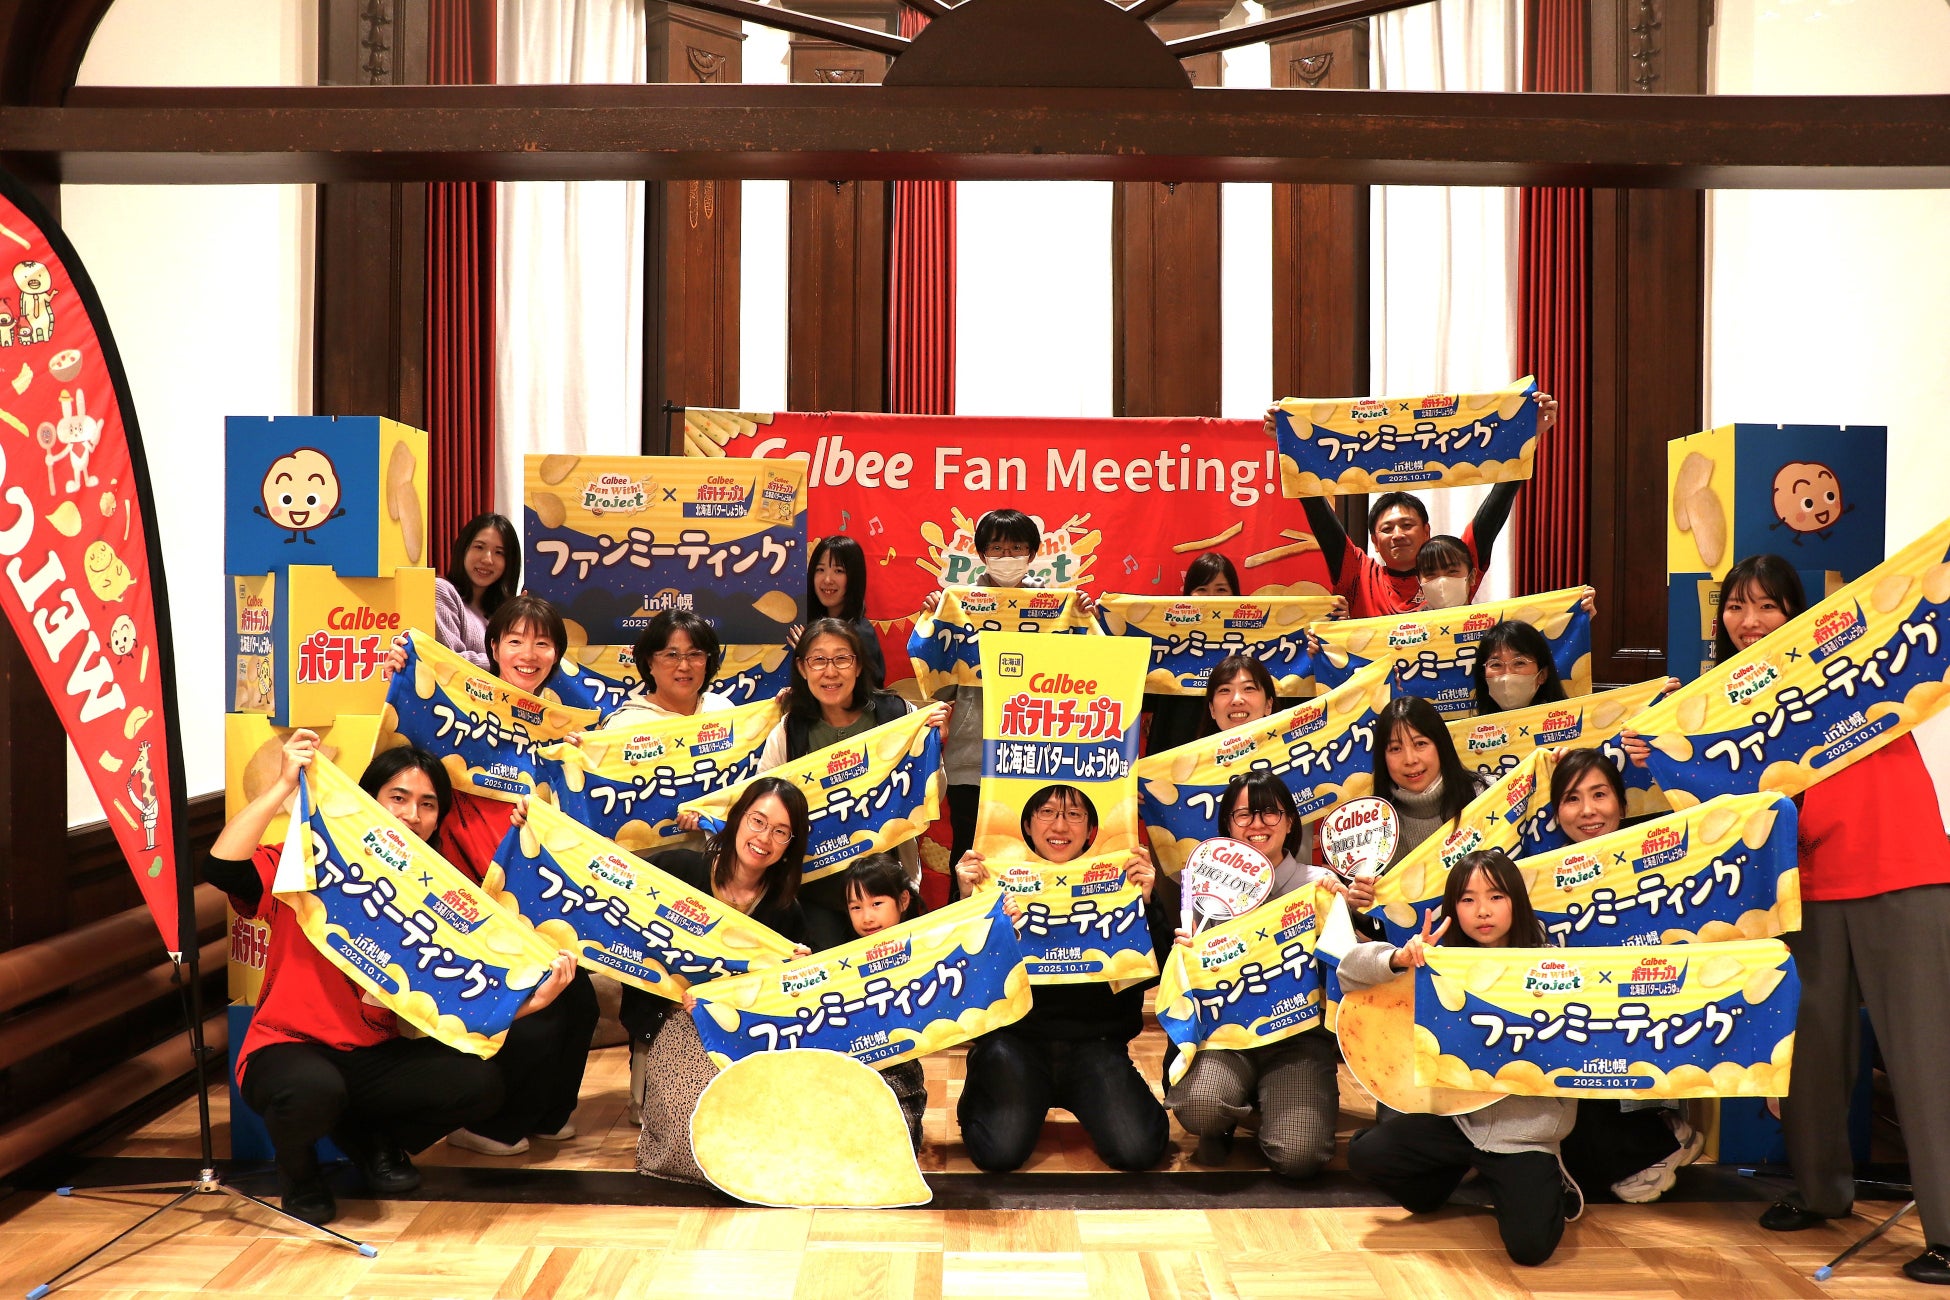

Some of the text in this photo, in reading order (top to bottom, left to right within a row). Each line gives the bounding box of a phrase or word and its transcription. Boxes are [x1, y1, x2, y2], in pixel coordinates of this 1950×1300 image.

[1352, 408, 1388, 418] Project
[1318, 421, 1498, 462] ファンミーティング
[707, 476, 734, 485] Calbee
[751, 435, 1275, 508] lbee Fan Meeting!
[1389, 474, 1431, 482] 2025.10.17
[588, 484, 641, 496] Fan With!
[601, 476, 628, 486] Calbee
[584, 492, 644, 508] Project
[697, 485, 746, 502] ポテトチップス
[536, 528, 796, 580] ファンミーティング
[644, 593, 694, 612] in札幌
[961, 601, 996, 612] Project
[328, 606, 400, 630] Calbee
[1165, 612, 1200, 622] Project
[1815, 610, 1839, 627] Calbee
[1813, 612, 1857, 645] ポテトチップス
[1151, 632, 1302, 663] ァンミーティング
[1389, 632, 1428, 646] Project
[1002, 658, 1021, 666] 北海道
[1733, 664, 1754, 680] Calbee
[466, 682, 493, 701] Project
[1029, 673, 1098, 694] Calbee
[1705, 612, 1938, 771] ファンミーティング
[1727, 667, 1778, 704] Project
[1438, 688, 1470, 700] in札幌
[1001, 694, 1123, 740] ポテトチップス
[1548, 710, 1567, 718] Calbee
[1822, 711, 1867, 743] in札幌
[1468, 734, 1507, 750] Project
[1826, 721, 1884, 760] 2025.10.17
[624, 745, 664, 760] Project
[831, 749, 850, 760] Calbee
[996, 742, 1129, 778] 北海道バターしょうゆ味
[1216, 742, 1256, 764] Project
[484, 778, 524, 792] 2025.10.17
[1335, 807, 1378, 832] Calbee
[386, 830, 405, 848] Calbee
[1445, 830, 1462, 846] Calbee
[1647, 827, 1670, 838] Calbee
[363, 832, 407, 872] Project
[814, 834, 850, 855] in札幌
[1332, 836, 1354, 853] BIG
[1642, 831, 1681, 856] ポテトチップス
[608, 855, 628, 869] Calbee
[814, 846, 861, 868] 2025.10.17
[1212, 847, 1261, 877] Calbee
[1564, 855, 1585, 866] Calbee
[1573, 857, 1596, 872] With!
[588, 860, 634, 890] Project
[1195, 862, 1262, 900] BIG LOVE
[1556, 864, 1601, 887] Project
[458, 888, 478, 906] Calbee
[686, 897, 706, 912] Calbee
[1540, 856, 1747, 947] ァンミーティング
[442, 890, 480, 924] ポテトチップス
[672, 899, 711, 926] ポテトチップス
[1285, 900, 1304, 913] Calbee
[354, 933, 392, 968] in札幌
[610, 940, 643, 963] in札幌
[1208, 937, 1228, 948] Calbee
[1045, 948, 1082, 961] in札幌
[1202, 943, 1246, 968] Project
[1641, 958, 1667, 966] Calbee
[340, 944, 388, 984] 2025.10.17
[598, 954, 649, 978] 2025.10.17
[1038, 964, 1090, 973] 2025.10.17
[1541, 962, 1565, 970] Calbee
[782, 970, 827, 992] Project
[1529, 969, 1577, 978] Fan With!
[1631, 966, 1677, 981] ポテトチップス
[1526, 976, 1580, 990] Project
[1272, 993, 1307, 1016] in札幌
[1470, 1004, 1742, 1052] ファンミーティング
[850, 1030, 888, 1053] in札幌
[858, 1044, 900, 1064] 25.10.17
[1583, 1058, 1628, 1073] in札幌
[1574, 1078, 1637, 1087] 2025.10.17
